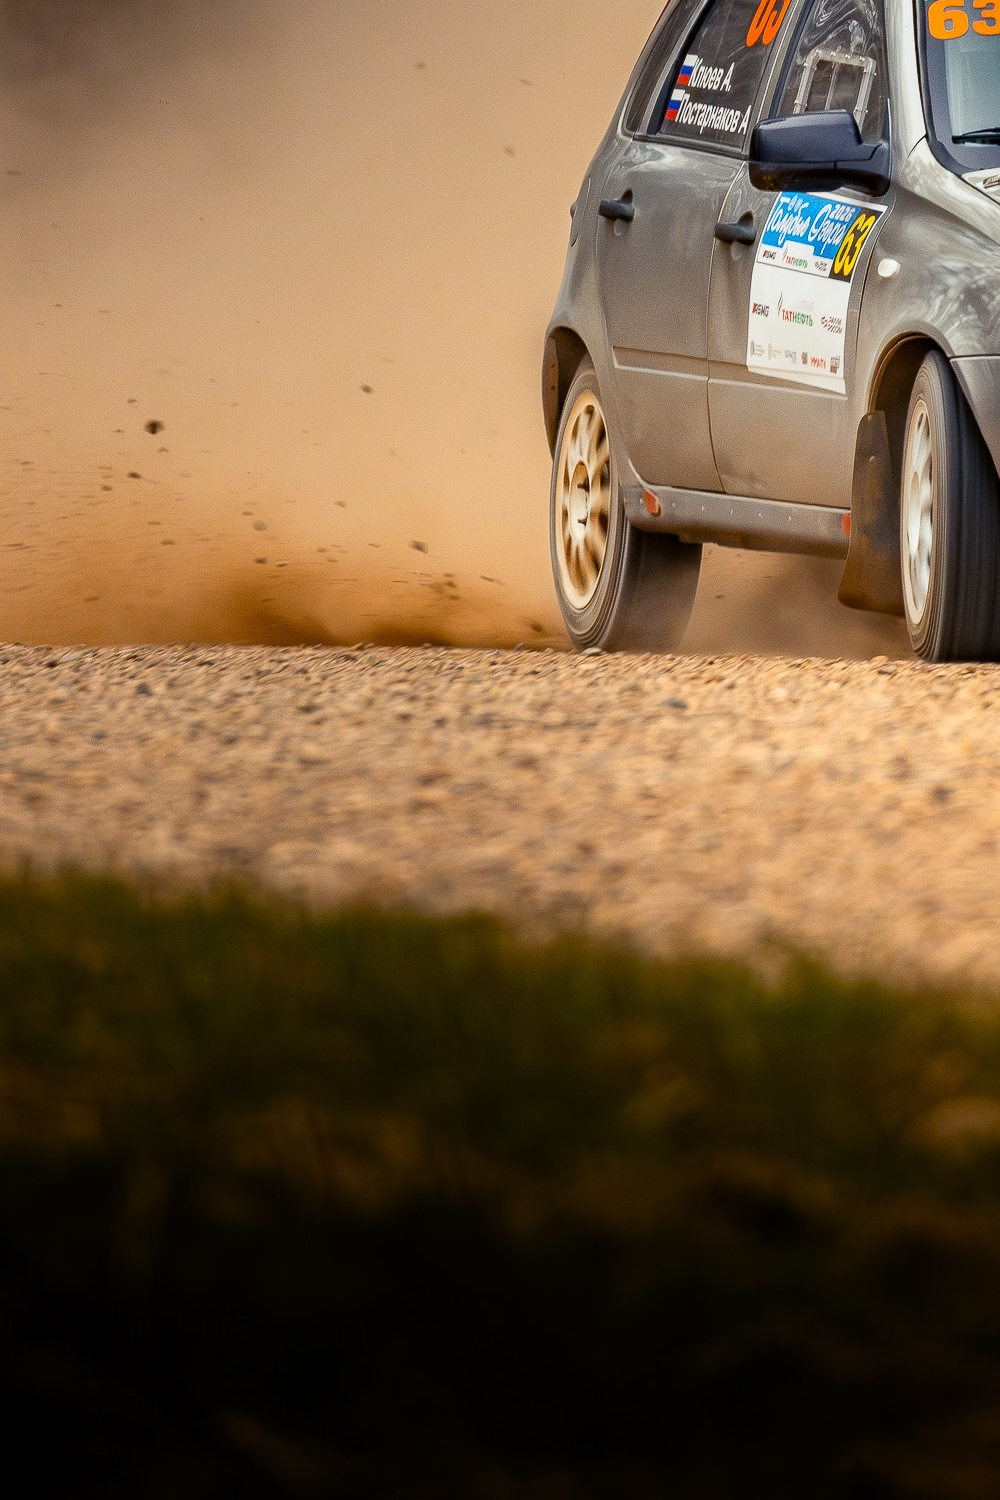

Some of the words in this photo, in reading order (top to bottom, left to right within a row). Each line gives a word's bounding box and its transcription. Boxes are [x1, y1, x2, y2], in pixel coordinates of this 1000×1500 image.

[687, 57, 725, 91] Клюев
[833, 213, 876, 277] 63
[782, 309, 814, 327] ТАТНЕФТЬ
